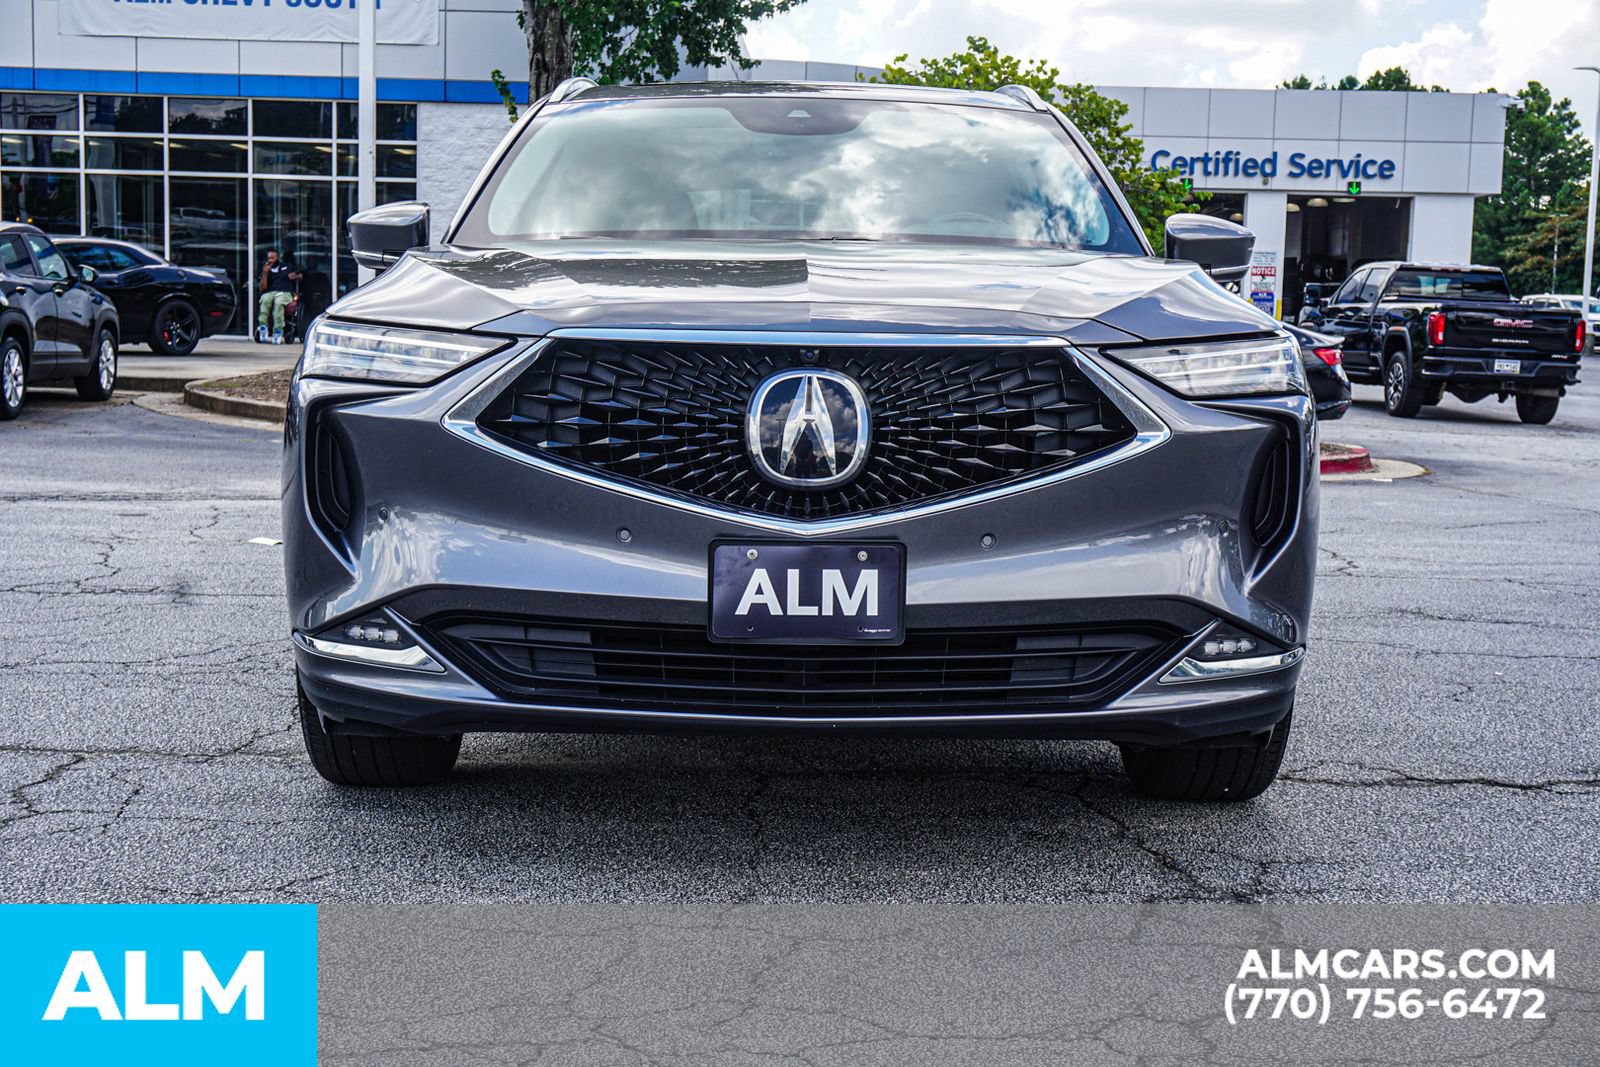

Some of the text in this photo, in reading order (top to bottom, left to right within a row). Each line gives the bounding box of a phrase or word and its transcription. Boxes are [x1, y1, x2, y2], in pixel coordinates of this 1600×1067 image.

[1151, 149, 1396, 179] Certified Service
[1251, 267, 1276, 275] NOTICE
[1493, 318, 1534, 328] GMC
[734, 568, 879, 616] ALM
